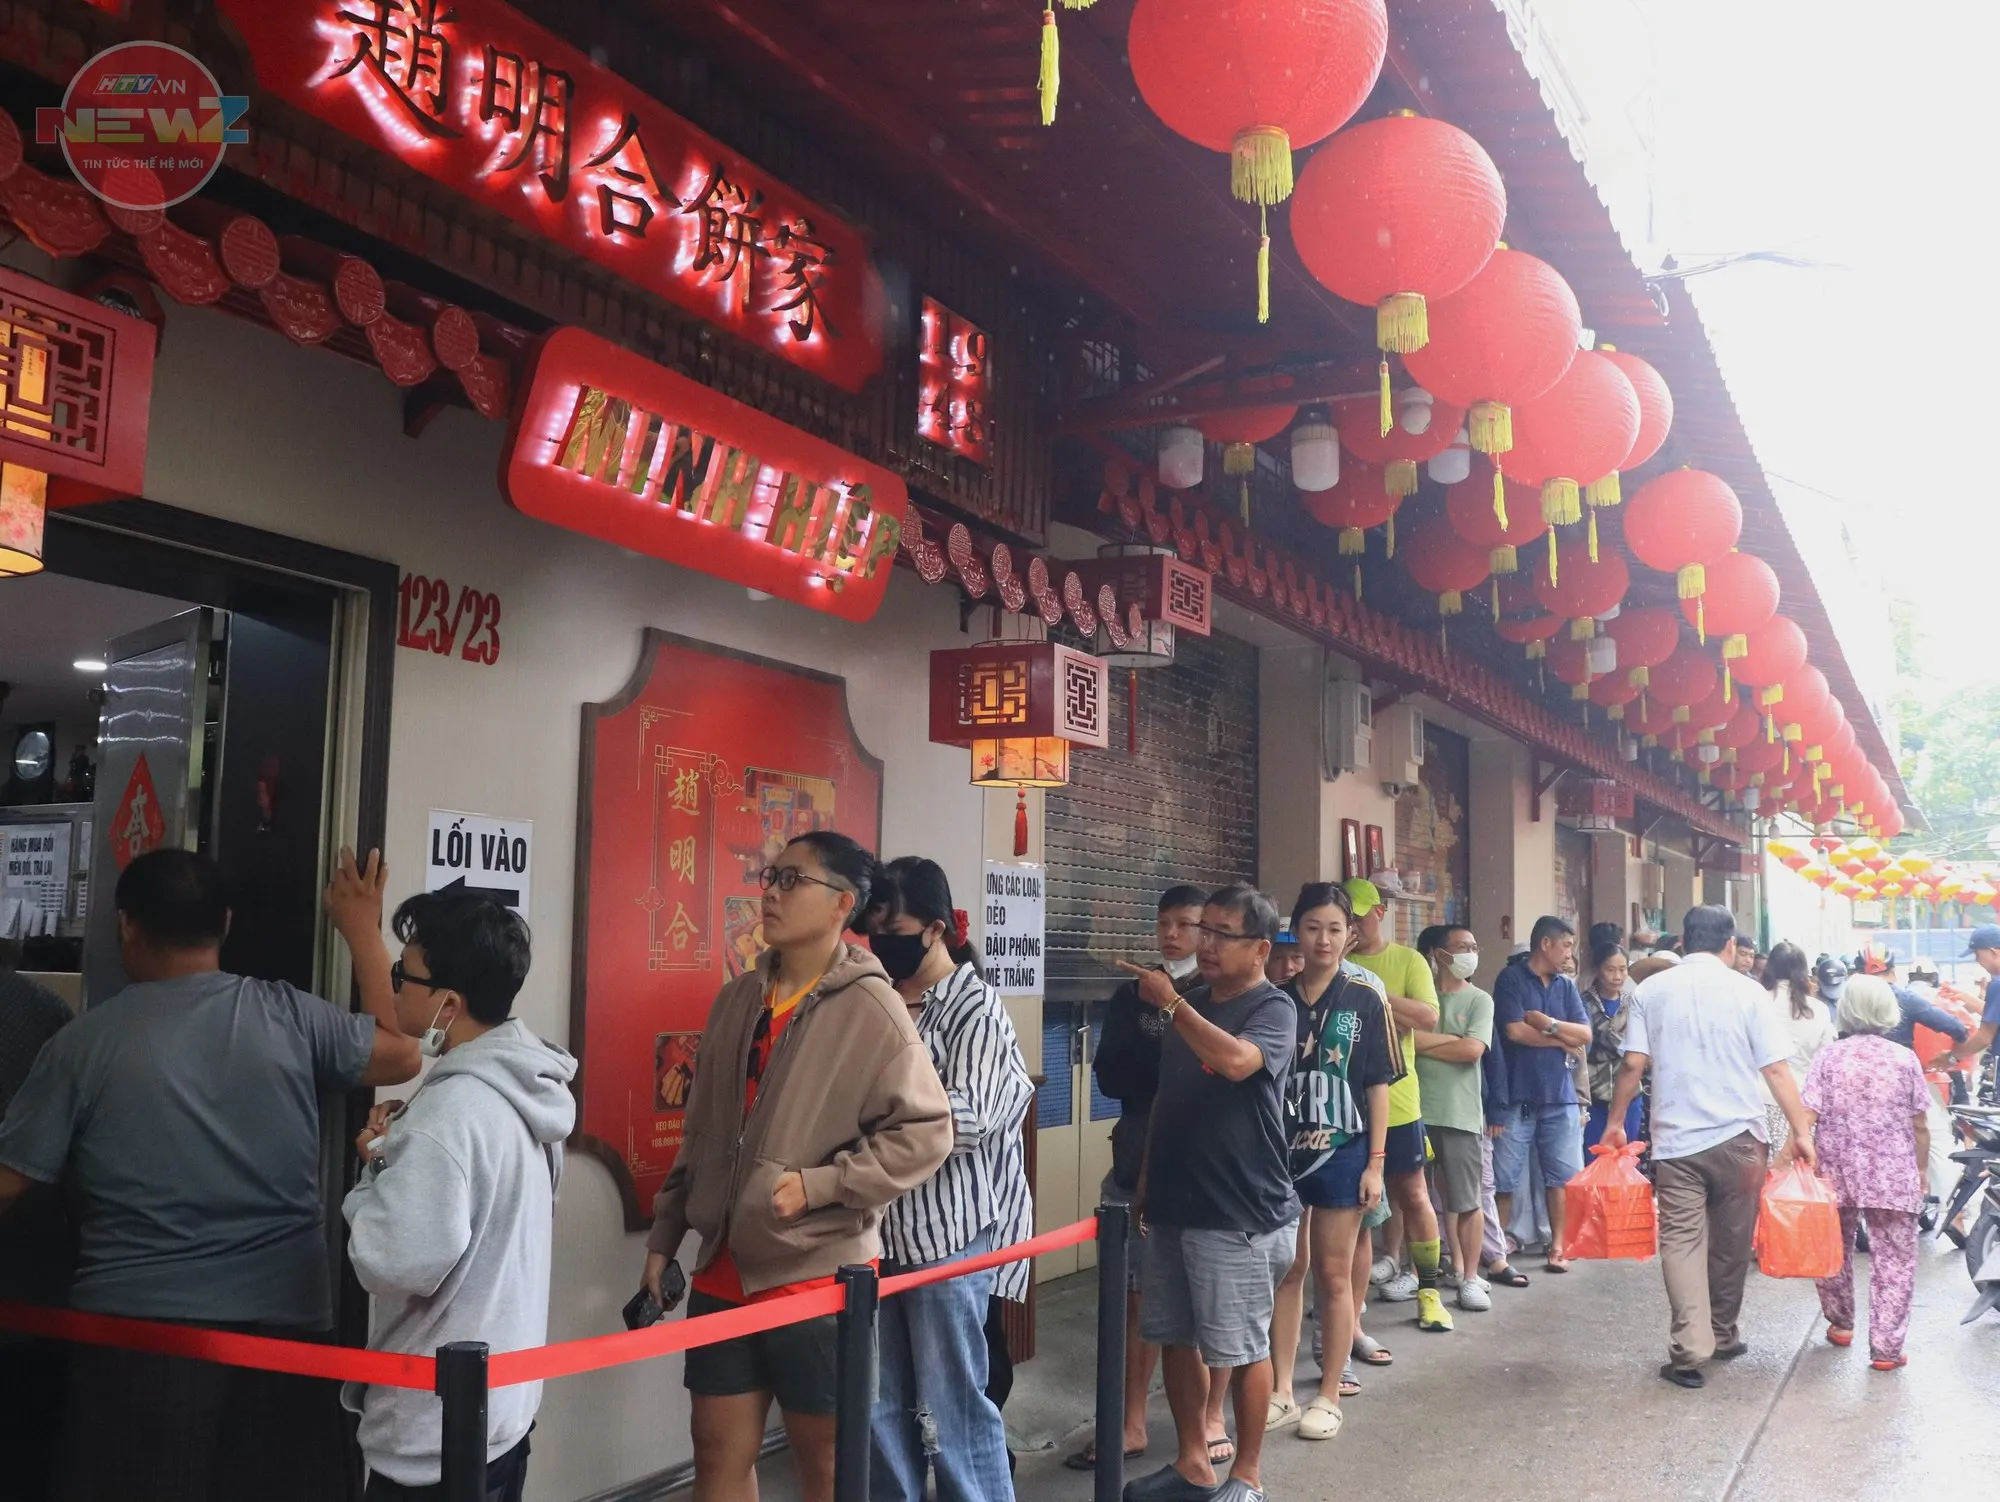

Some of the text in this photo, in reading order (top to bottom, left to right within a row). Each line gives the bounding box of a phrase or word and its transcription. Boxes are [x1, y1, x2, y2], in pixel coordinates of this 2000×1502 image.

[330, 0, 842, 341] 趙明合餅家
[397, 572, 501, 666] 123/23
[431, 817, 528, 874] LỐI VÀO
[667, 767, 701, 951] 趙明合
[1005, 871, 1021, 898] CÁC
[986, 899, 1006, 926] DẺO
[986, 932, 1041, 961] ĐẬU PHỘNG
[986, 959, 1035, 988] MÈ TRẮNG
